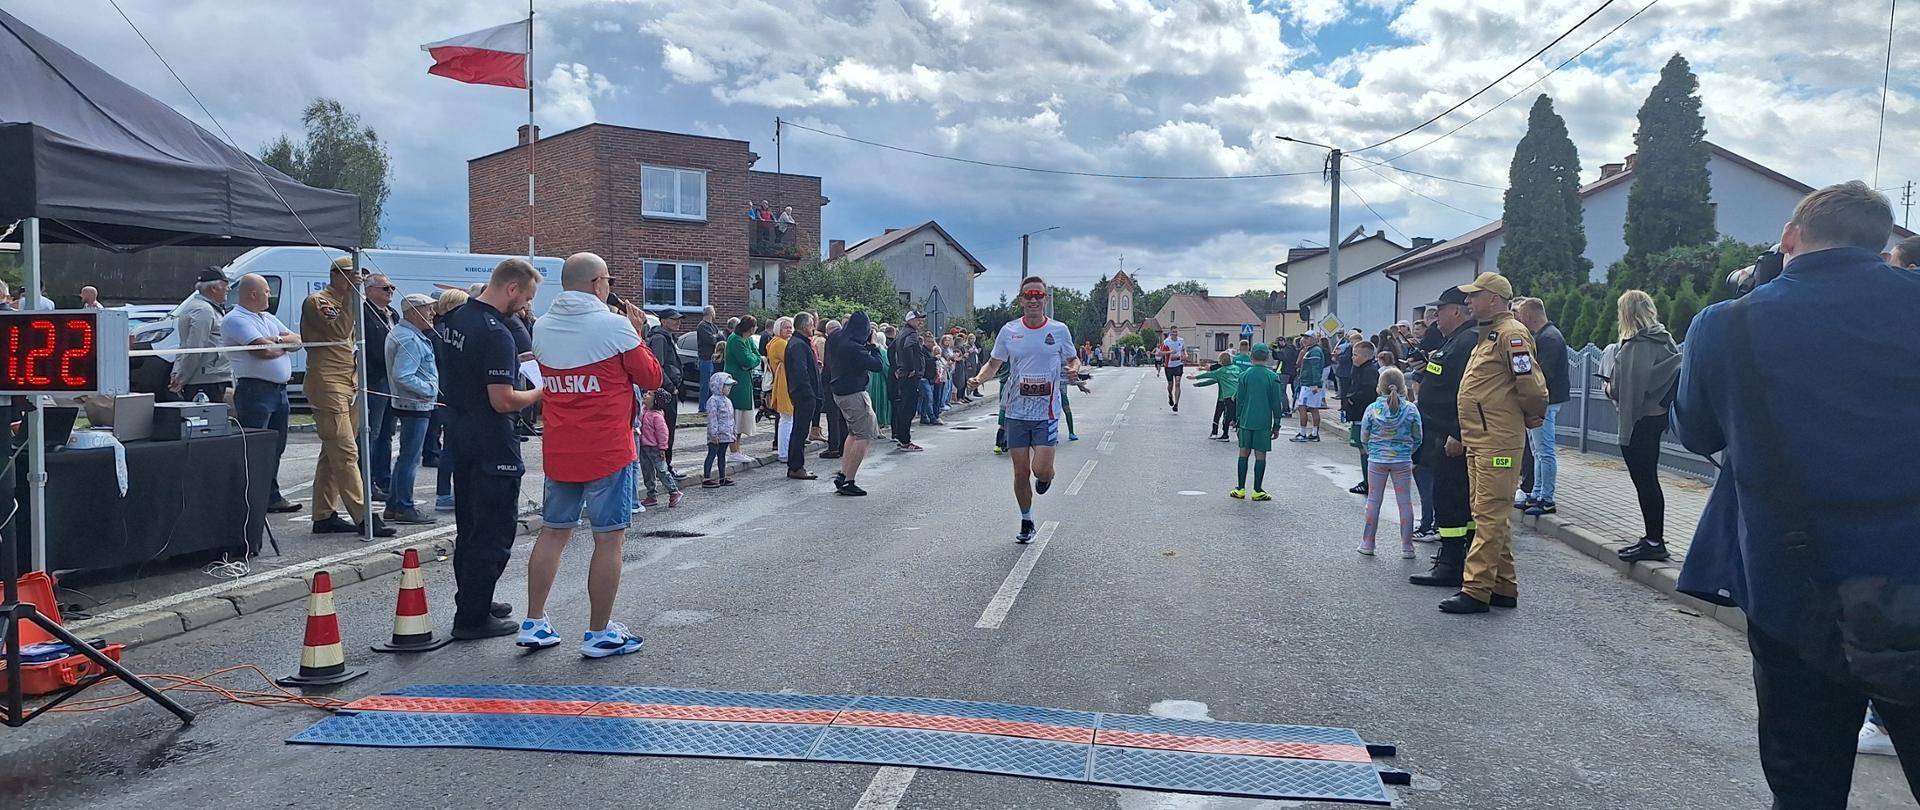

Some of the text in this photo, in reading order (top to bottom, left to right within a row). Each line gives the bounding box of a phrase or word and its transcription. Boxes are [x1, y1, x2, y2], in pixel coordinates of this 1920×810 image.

[543, 375, 600, 393] POLSKA
[1023, 383, 1046, 393] 998
[1495, 457, 1509, 466] OSP
